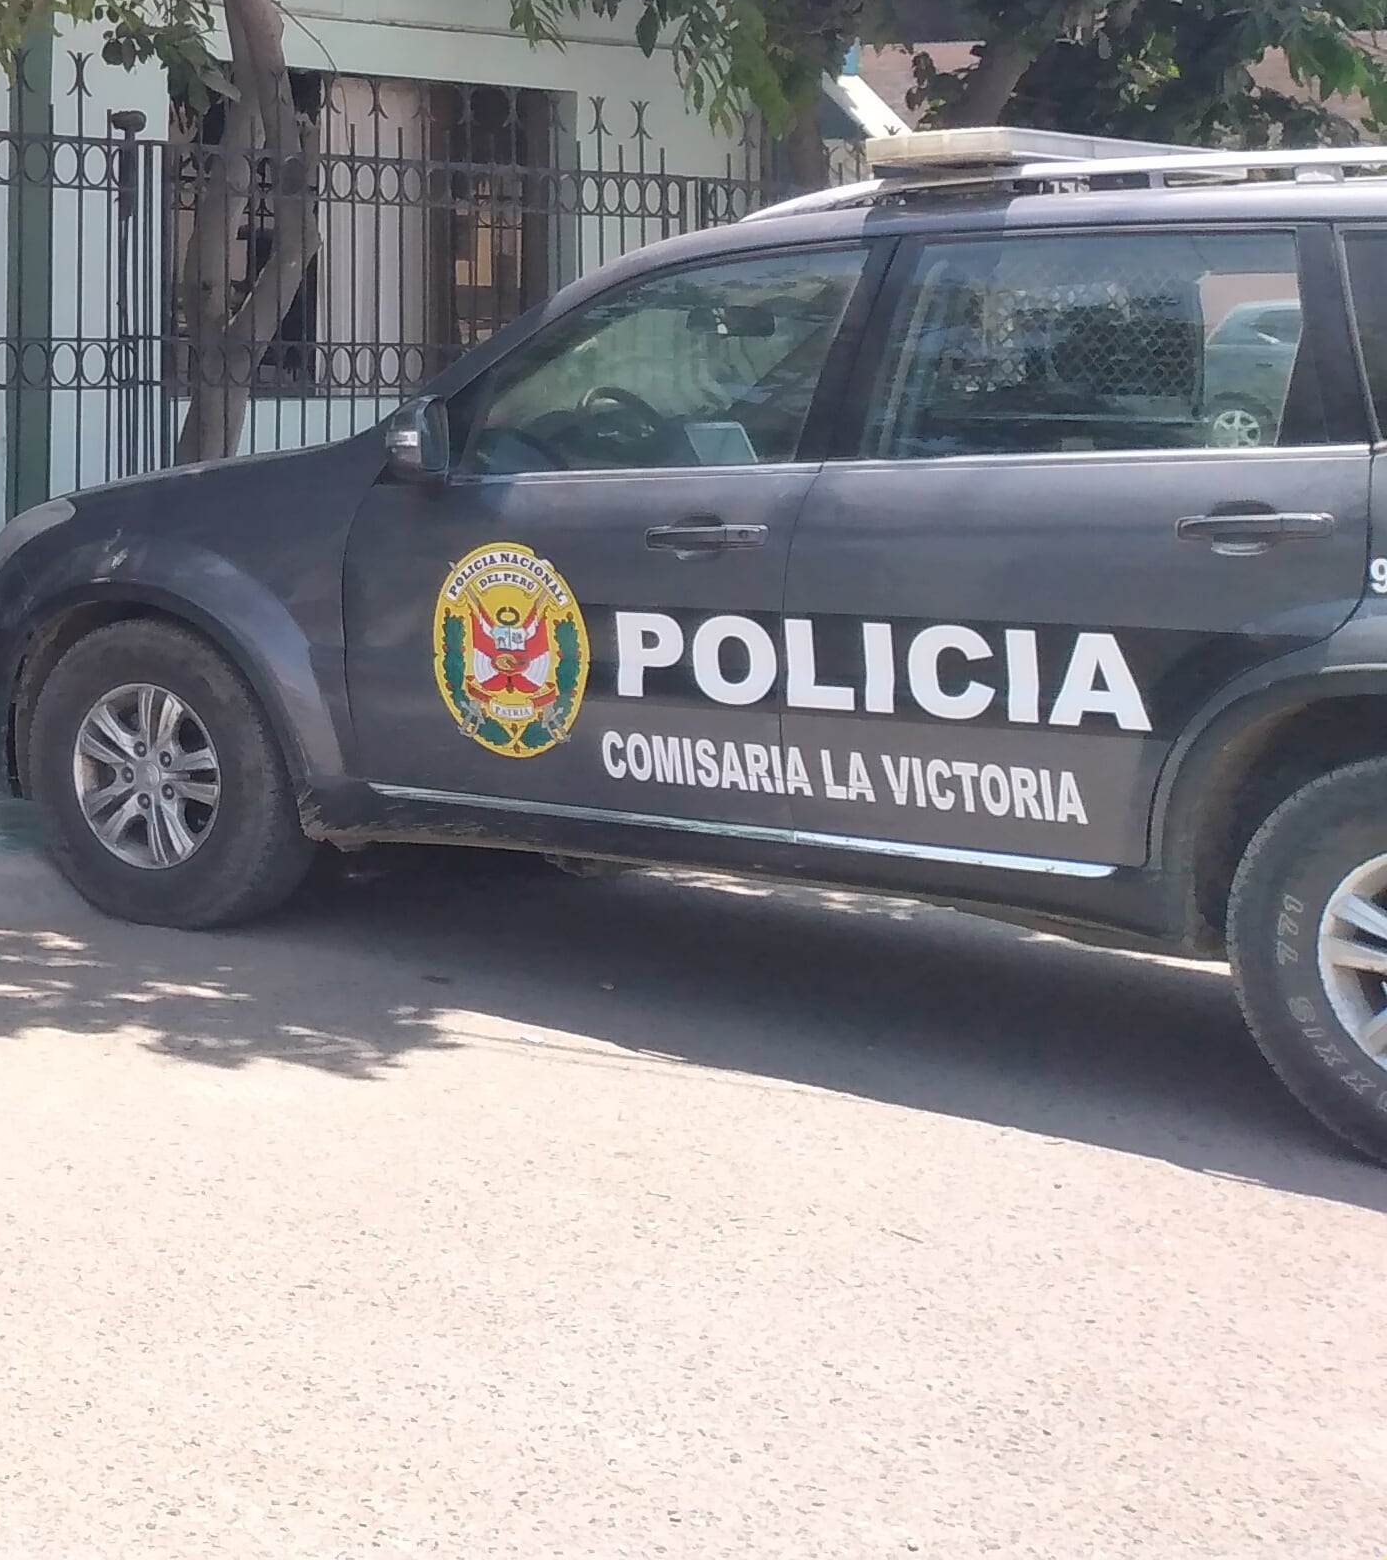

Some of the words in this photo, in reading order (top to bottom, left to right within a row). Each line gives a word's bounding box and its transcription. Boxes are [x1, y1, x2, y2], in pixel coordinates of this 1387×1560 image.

[448, 554, 497, 597] POLICIA
[500, 553, 564, 604] NACIONAL
[479, 573, 502, 589] DEL
[615, 611, 1153, 732] POLICIA
[495, 706, 531, 716] PATRIA
[602, 730, 814, 797] COMISARIA
[820, 749, 876, 802] LA
[880, 754, 1089, 825] VICTORIA
